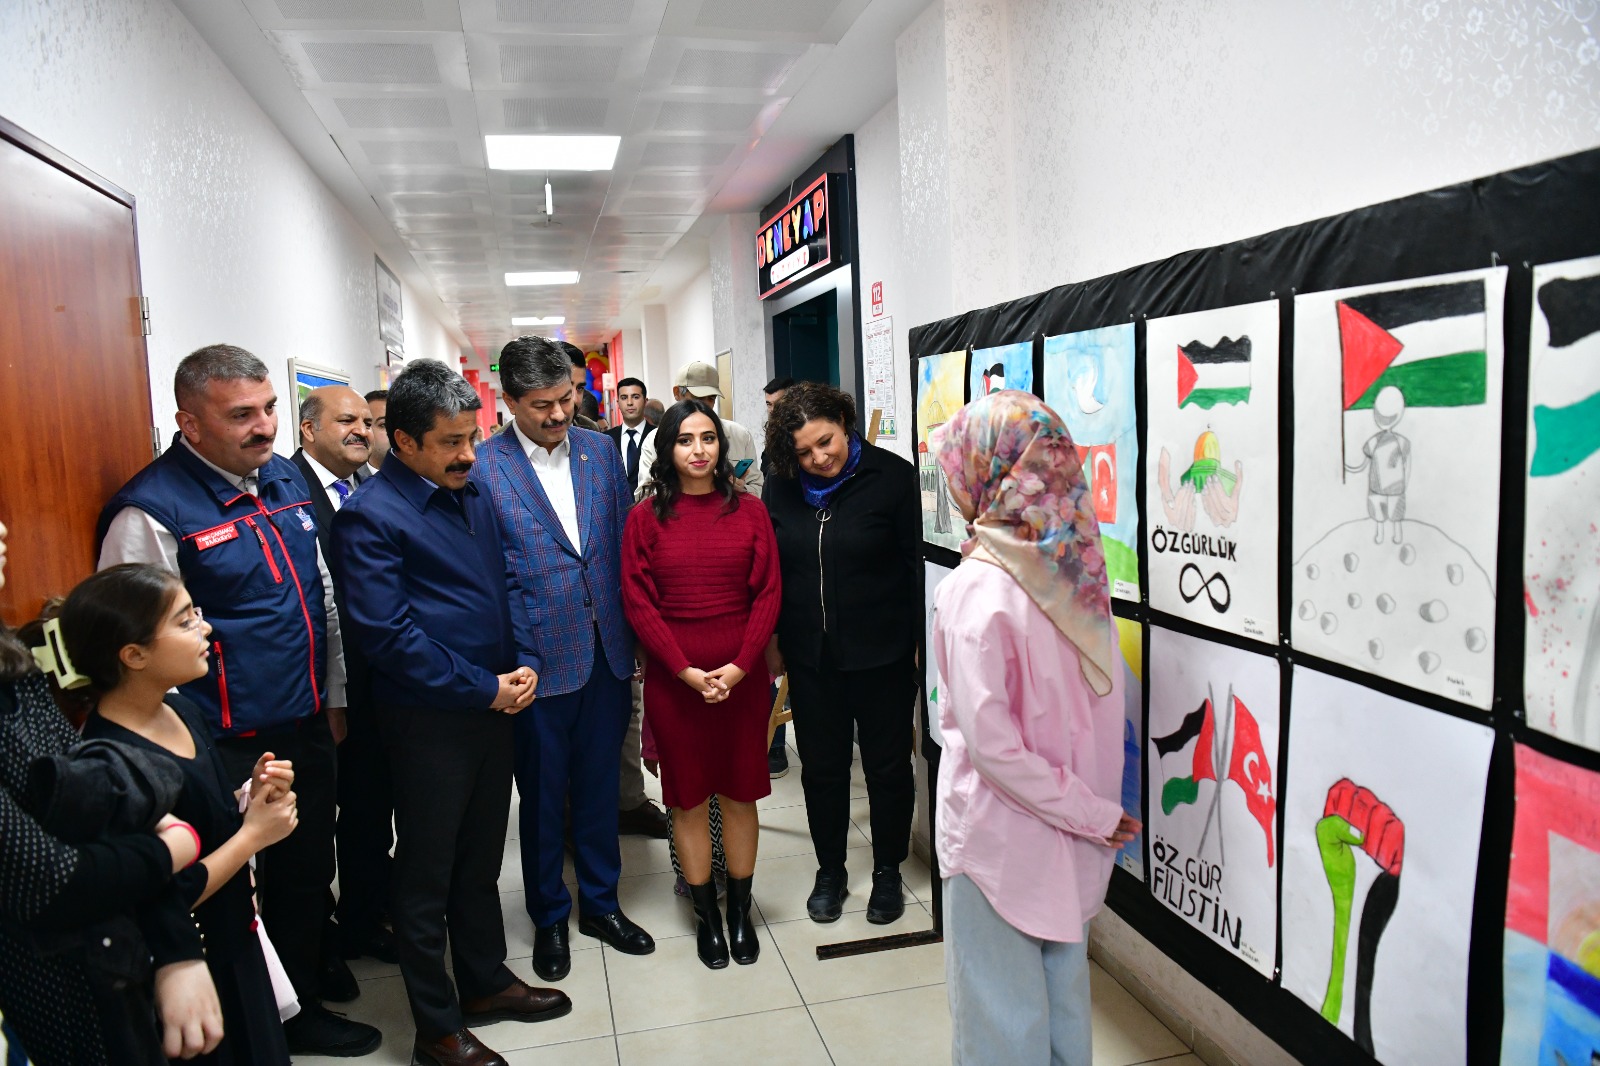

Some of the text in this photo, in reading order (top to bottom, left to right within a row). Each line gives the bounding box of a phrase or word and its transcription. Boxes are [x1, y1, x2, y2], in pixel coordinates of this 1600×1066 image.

[757, 189, 824, 269] DENEYAP
[872, 285, 881, 302] 112
[1152, 525, 1237, 562] ÖZGÜRLÜK
